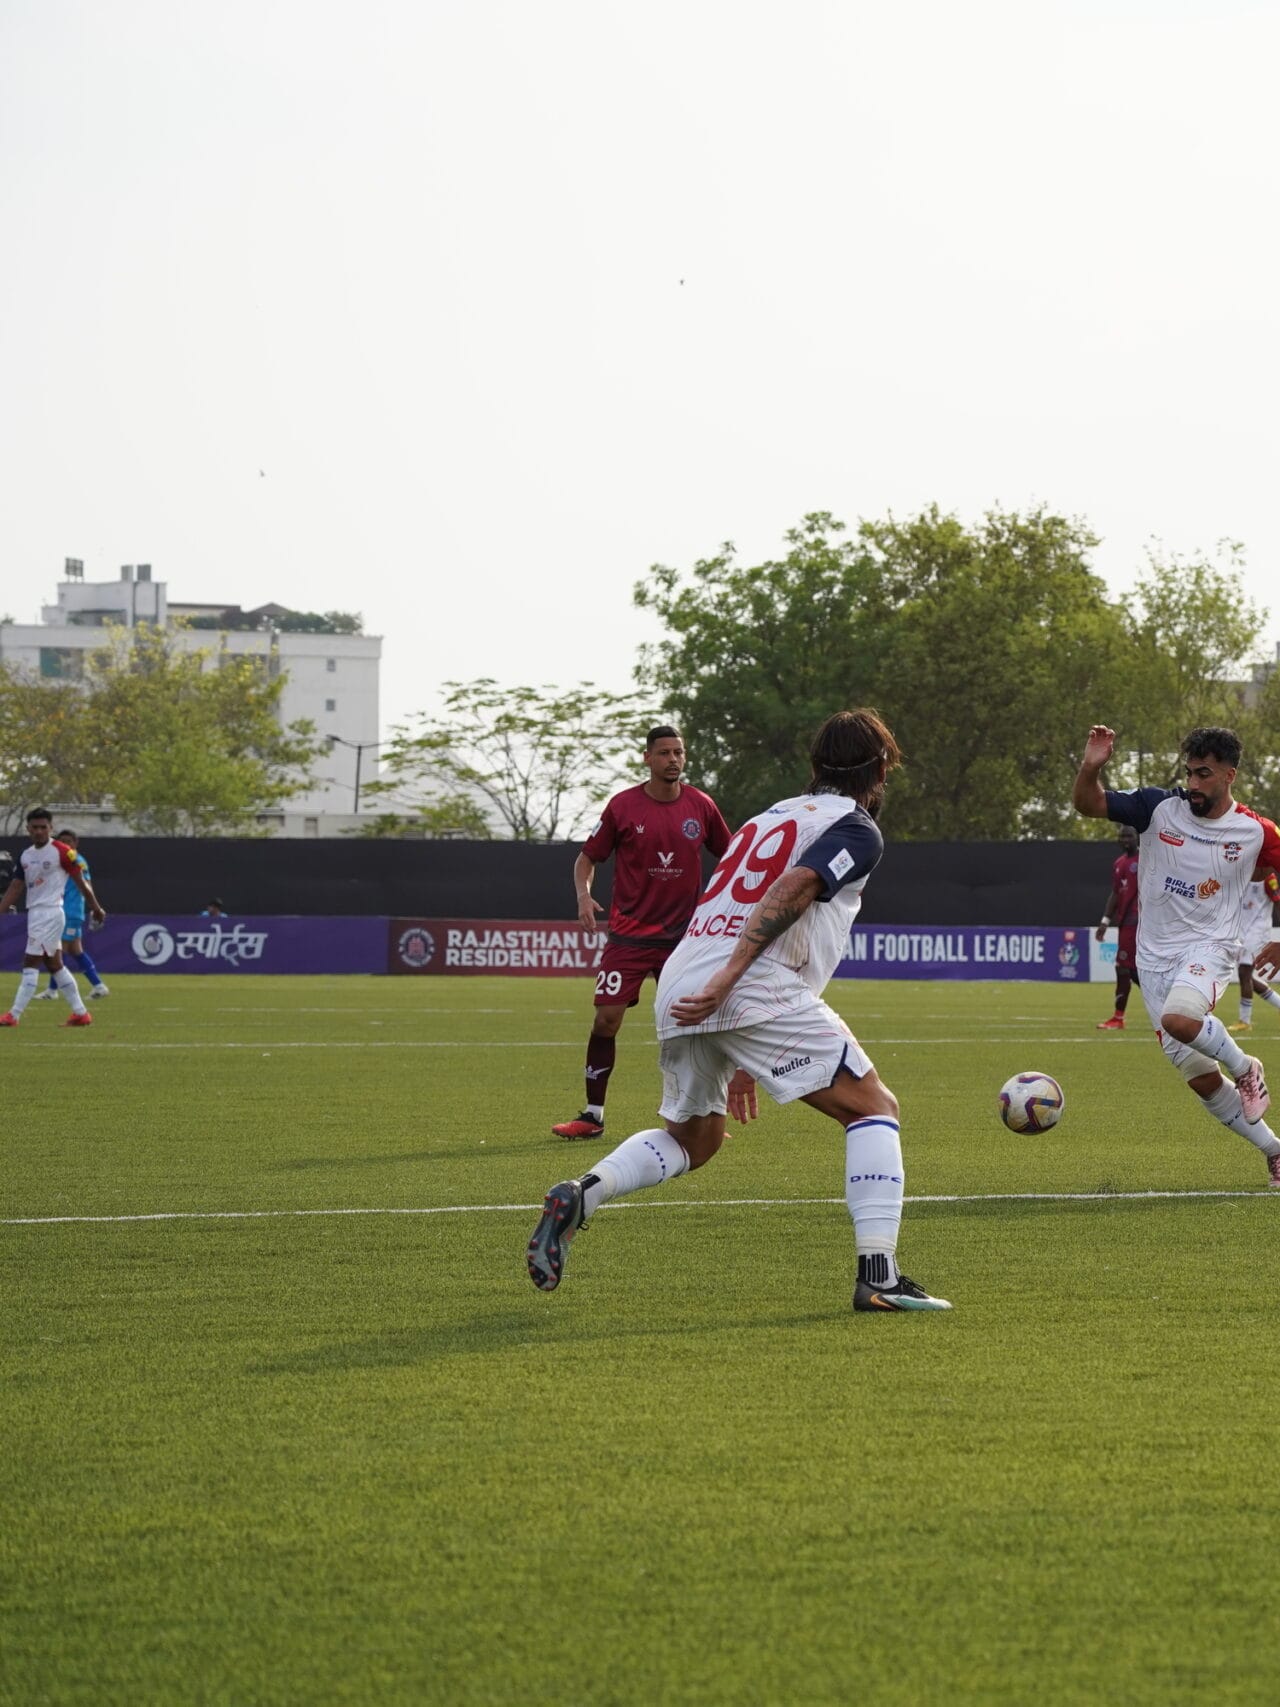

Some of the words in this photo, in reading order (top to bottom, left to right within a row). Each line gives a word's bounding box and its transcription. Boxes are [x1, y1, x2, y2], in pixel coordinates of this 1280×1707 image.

[697, 819, 798, 907] 99
[1164, 884, 1196, 899] TYRES
[1165, 876, 1196, 892] BIRLA
[688, 915, 749, 938] AJCE
[447, 929, 578, 950] RAJASTHAN
[873, 934, 969, 962] FOOTBALL
[974, 935, 1045, 963] LEAGUE
[445, 950, 588, 968] RESIDENTIAL
[594, 970, 623, 996] 29
[771, 1056, 812, 1078] Nautica
[850, 1174, 902, 1184] DHFC
